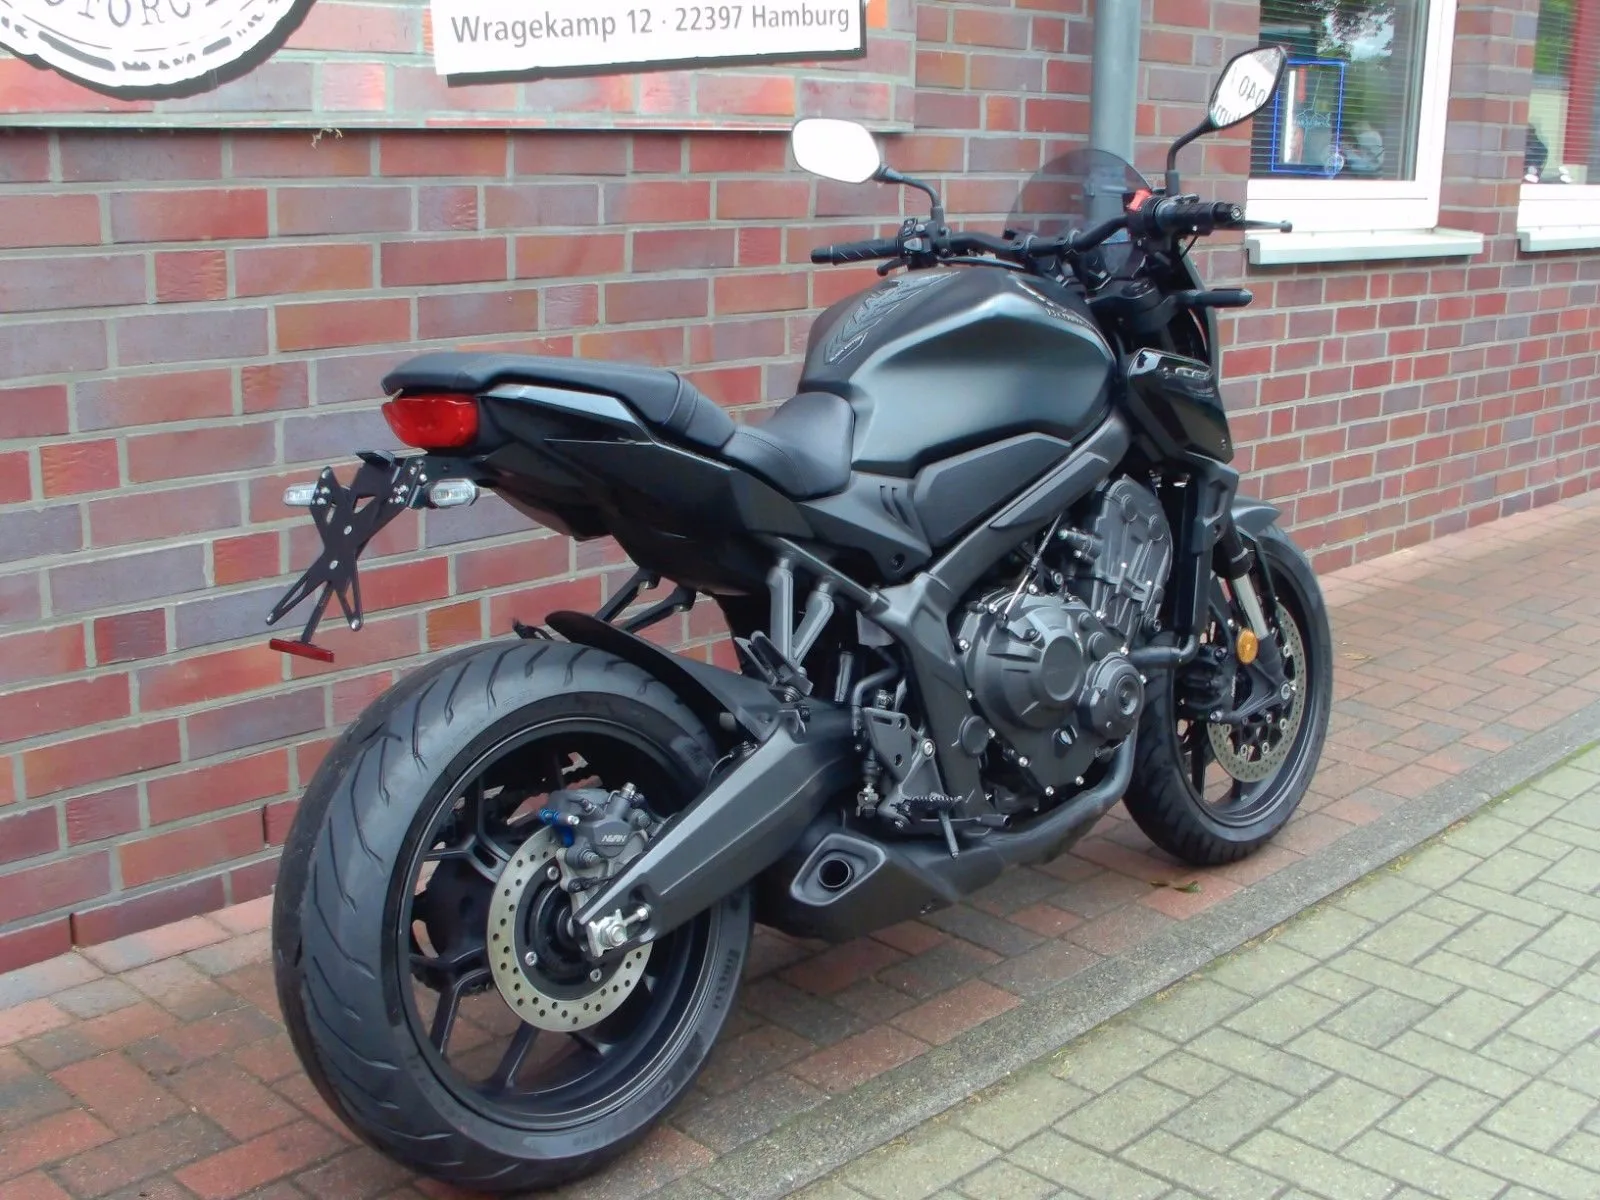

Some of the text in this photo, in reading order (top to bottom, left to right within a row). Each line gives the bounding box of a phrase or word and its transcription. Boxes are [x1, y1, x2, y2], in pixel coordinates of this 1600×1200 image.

[451, 2, 849, 49] Wragekamp 12 22397 Hamburg
